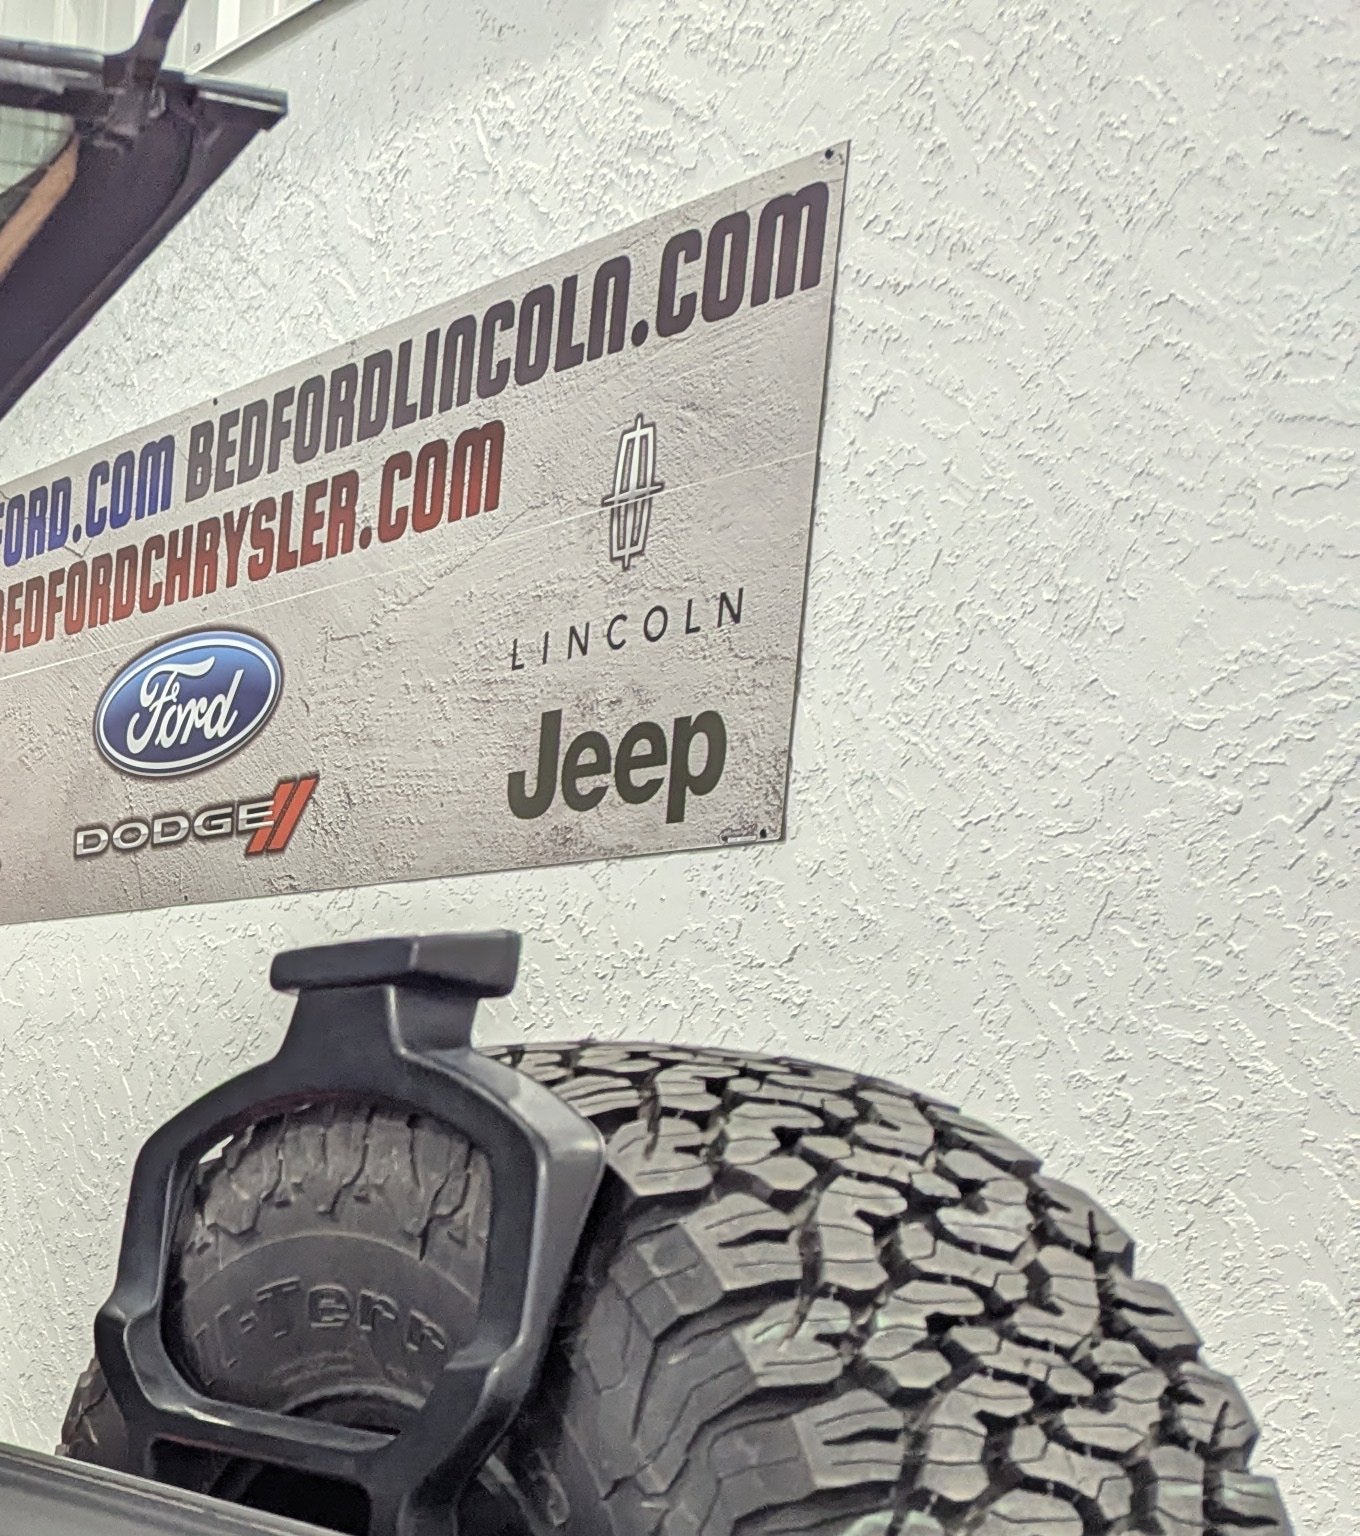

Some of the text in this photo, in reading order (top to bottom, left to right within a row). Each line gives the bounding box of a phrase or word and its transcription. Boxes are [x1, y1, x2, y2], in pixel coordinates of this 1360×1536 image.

[185, 180, 831, 503] BEDFORDLINCOLN.COM
[511, 587, 744, 671] LINCOLN
[126, 655, 245, 755] Ford
[507, 708, 728, 824] Jeep
[75, 799, 276, 857] DODGE
